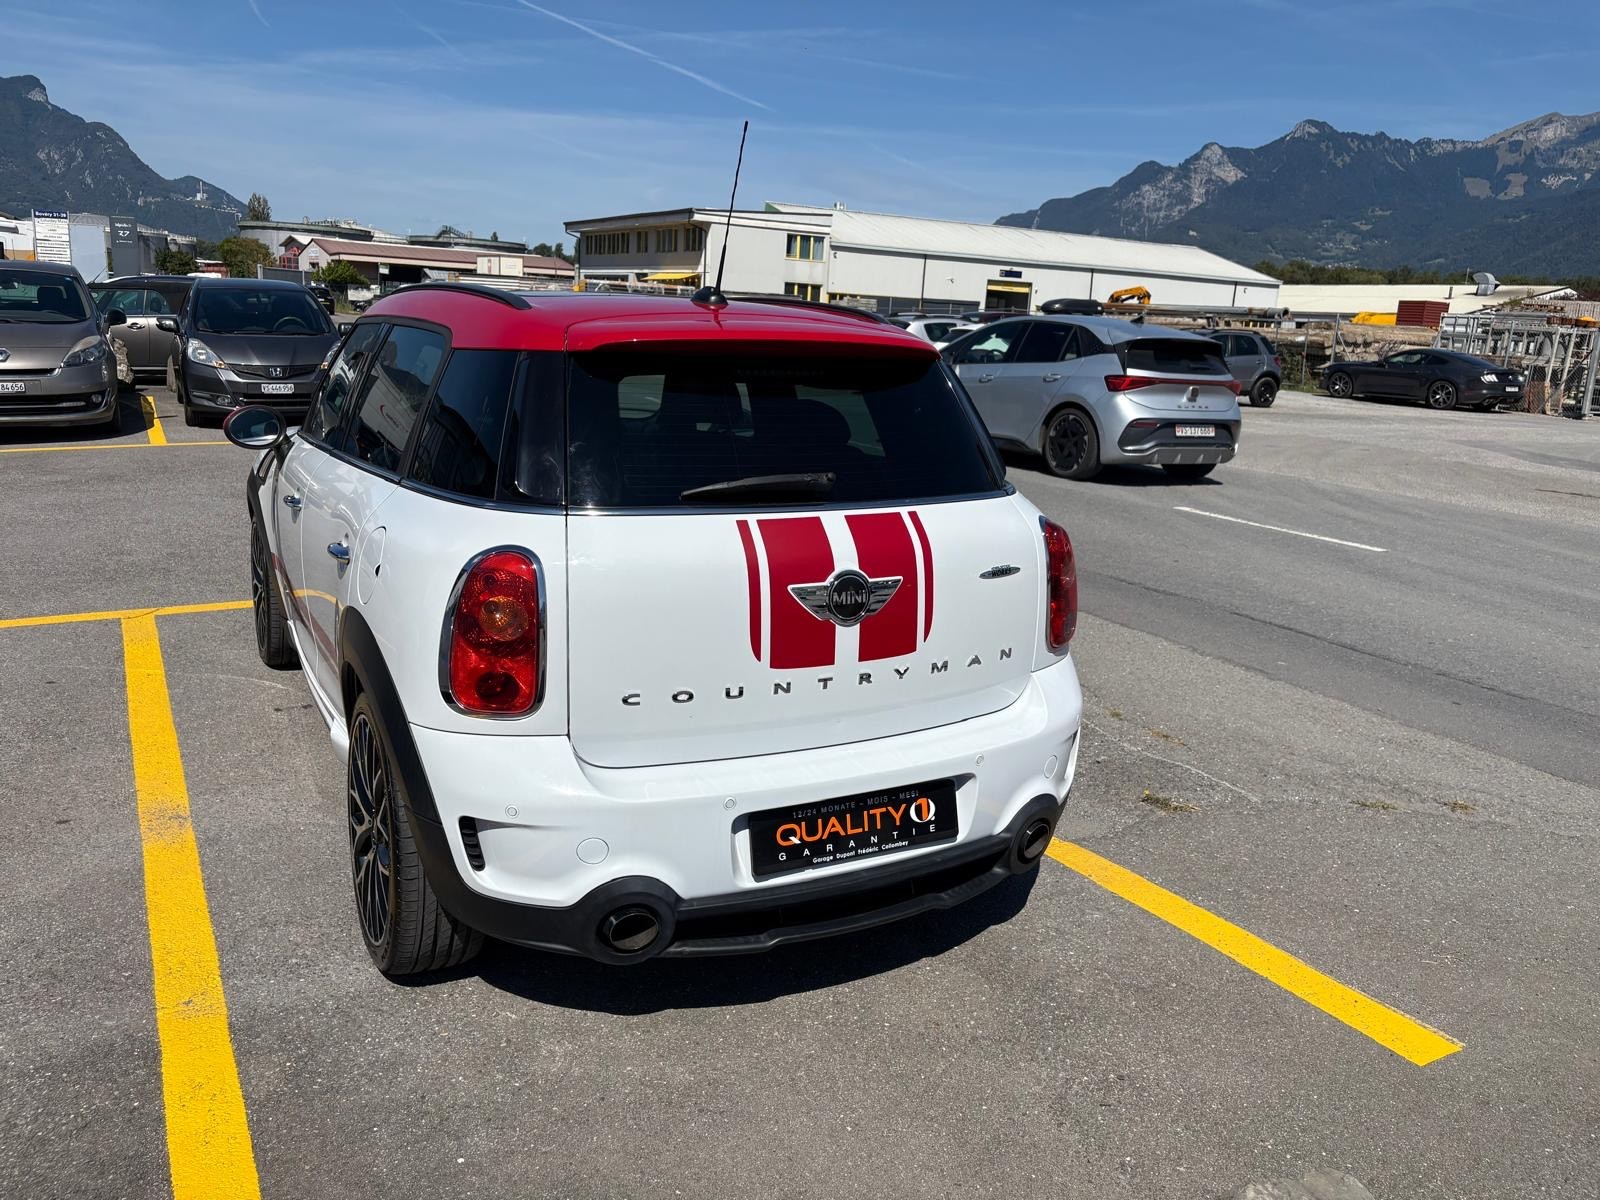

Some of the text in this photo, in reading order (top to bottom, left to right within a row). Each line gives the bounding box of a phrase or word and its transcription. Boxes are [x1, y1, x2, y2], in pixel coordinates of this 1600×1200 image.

[833, 589, 866, 605] MINI
[622, 648, 1012, 706] COUNTRYMAN
[820, 801, 856, 813] MONATE
[867, 795, 889, 805] MOIS
[776, 804, 908, 847] QUALITY
[778, 824, 936, 861] GARANTIE
[812, 855, 834, 864] Garage
[836, 850, 856, 859] Dupont
